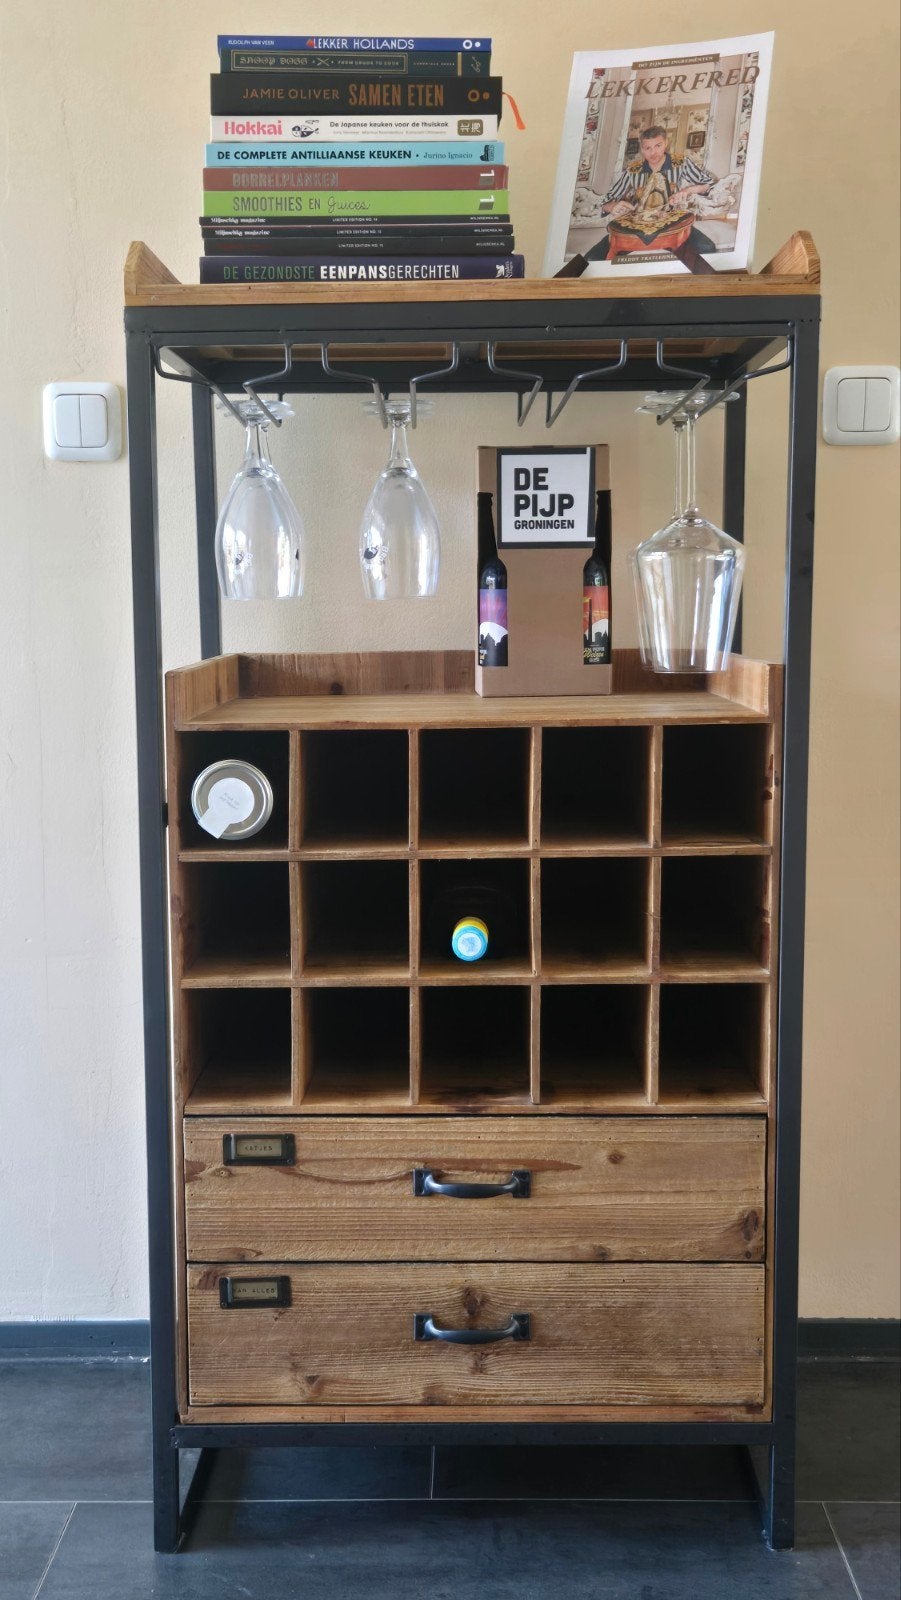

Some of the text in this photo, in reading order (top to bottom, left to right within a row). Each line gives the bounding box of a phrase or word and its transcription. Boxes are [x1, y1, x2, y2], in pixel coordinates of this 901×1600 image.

[313, 38, 414, 49] LEKKER HOLLANDS
[243, 88, 340, 99] JAMIE OLIVER
[349, 84, 444, 106] SAMEN ETEN
[224, 120, 283, 135] Hokkai
[218, 151, 230, 159] DE
[234, 151, 287, 160] COMPLETE
[291, 151, 365, 159] ANTILLIAANSE
[369, 150, 412, 159] KEUKEN
[233, 196, 302, 211] SMOOTHIES
[309, 199, 321, 209] EN
[224, 265, 459, 279] DE GEZONDSTE EENPANSGERECHTEN
[514, 468, 549, 491] DE
[514, 493, 574, 518] PIJP
[514, 519, 574, 530] GRONINGEN
